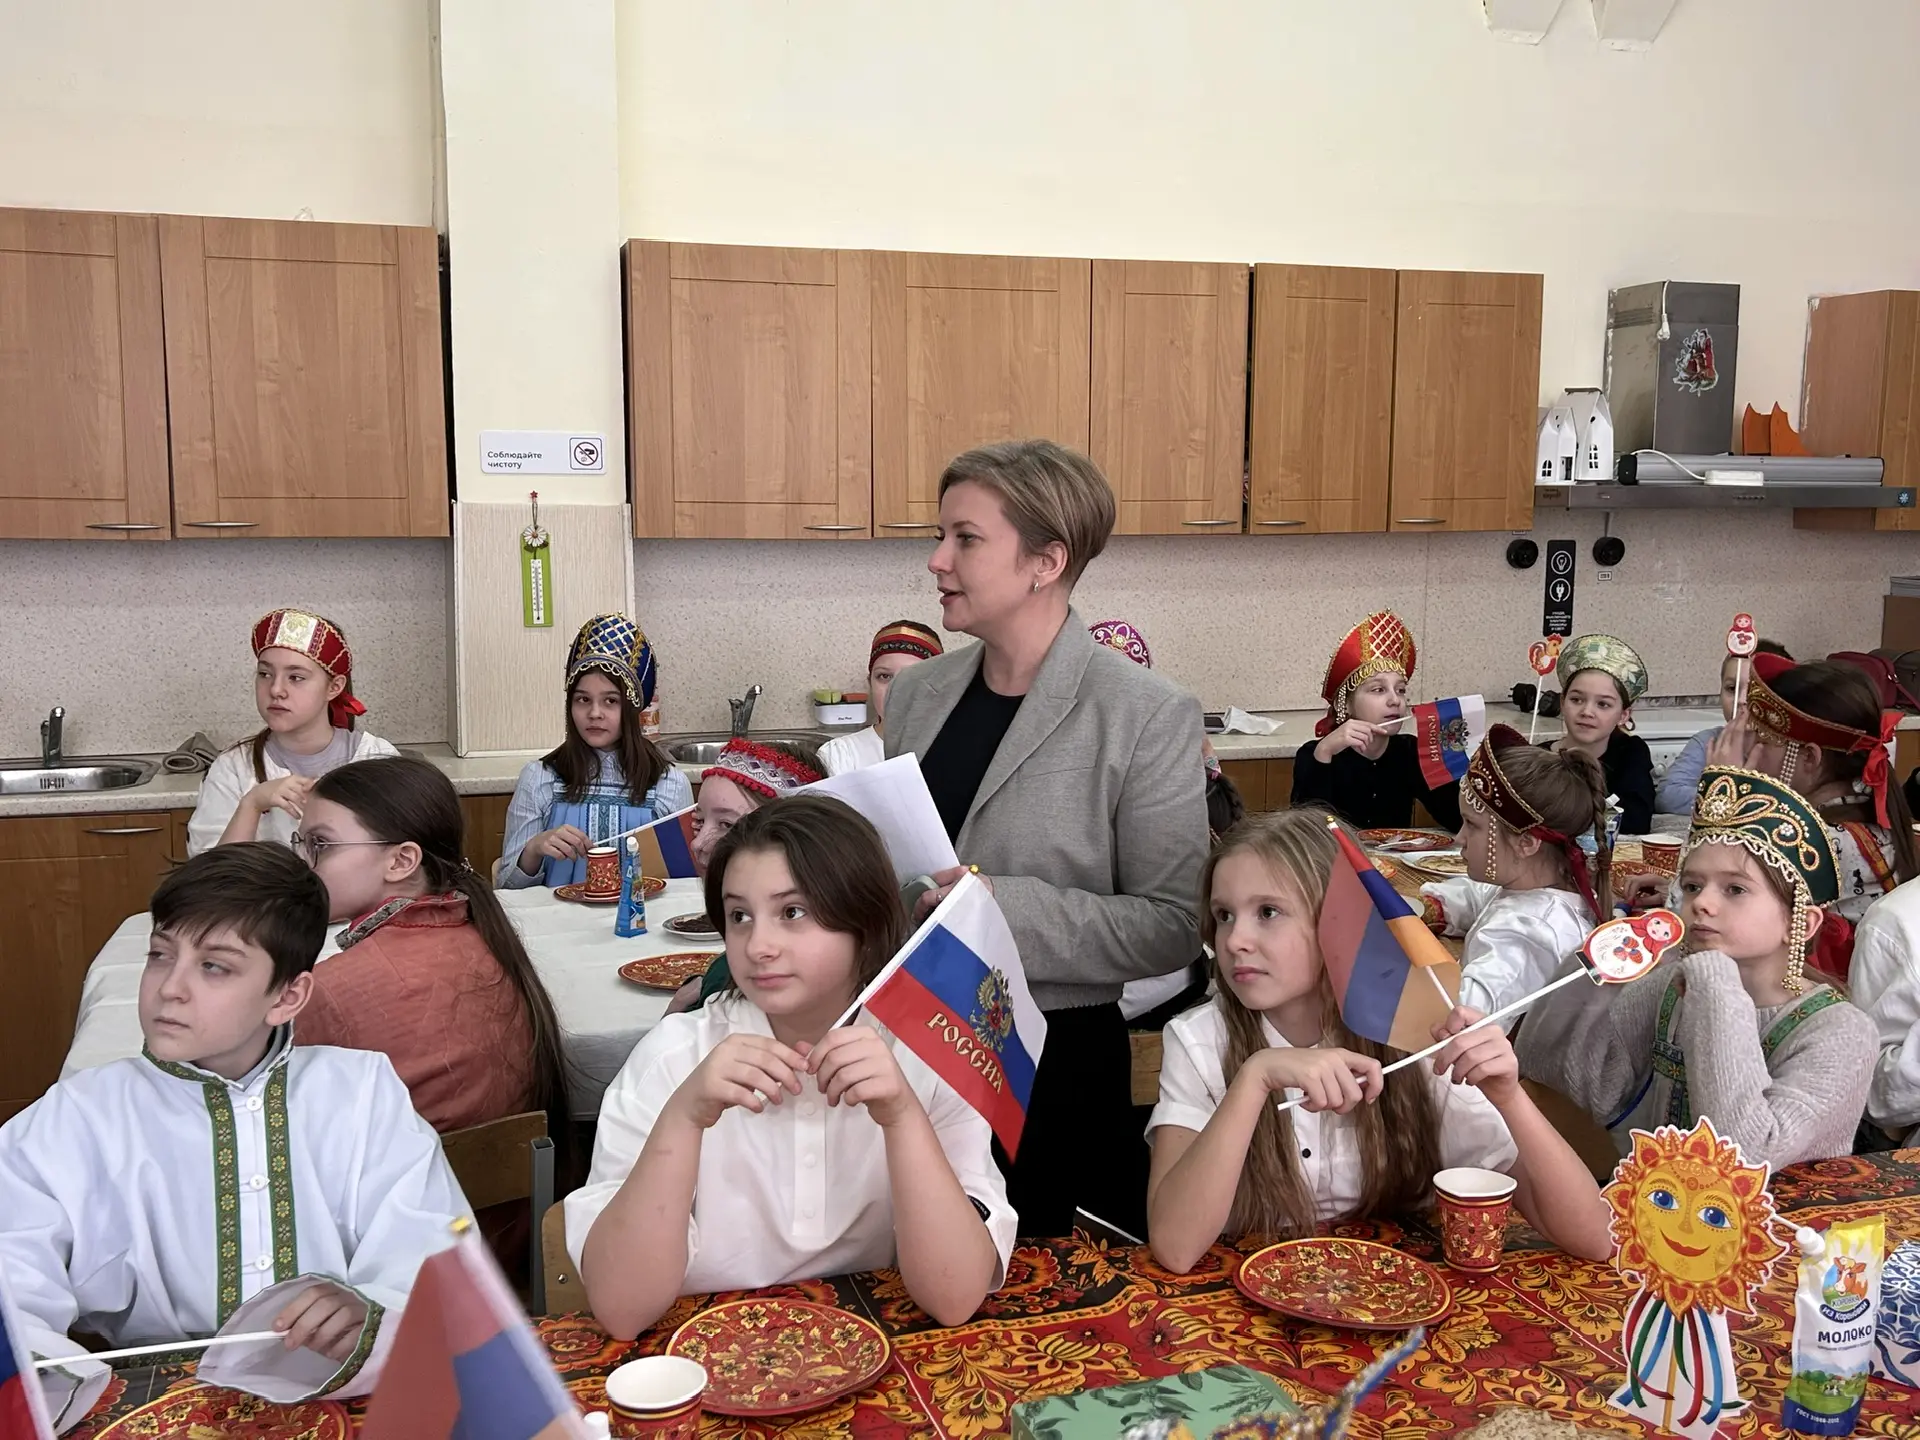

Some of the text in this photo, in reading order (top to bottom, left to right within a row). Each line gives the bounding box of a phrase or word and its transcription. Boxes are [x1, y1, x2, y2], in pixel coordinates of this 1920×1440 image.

[487, 451, 542, 461] Соблюдайте
[487, 461, 522, 469] чистоту
[1427, 715, 1440, 761] РОССИЯ
[926, 1012, 1004, 1095] РОССИЯ
[1818, 1325, 1872, 1344] МОЛОКО
